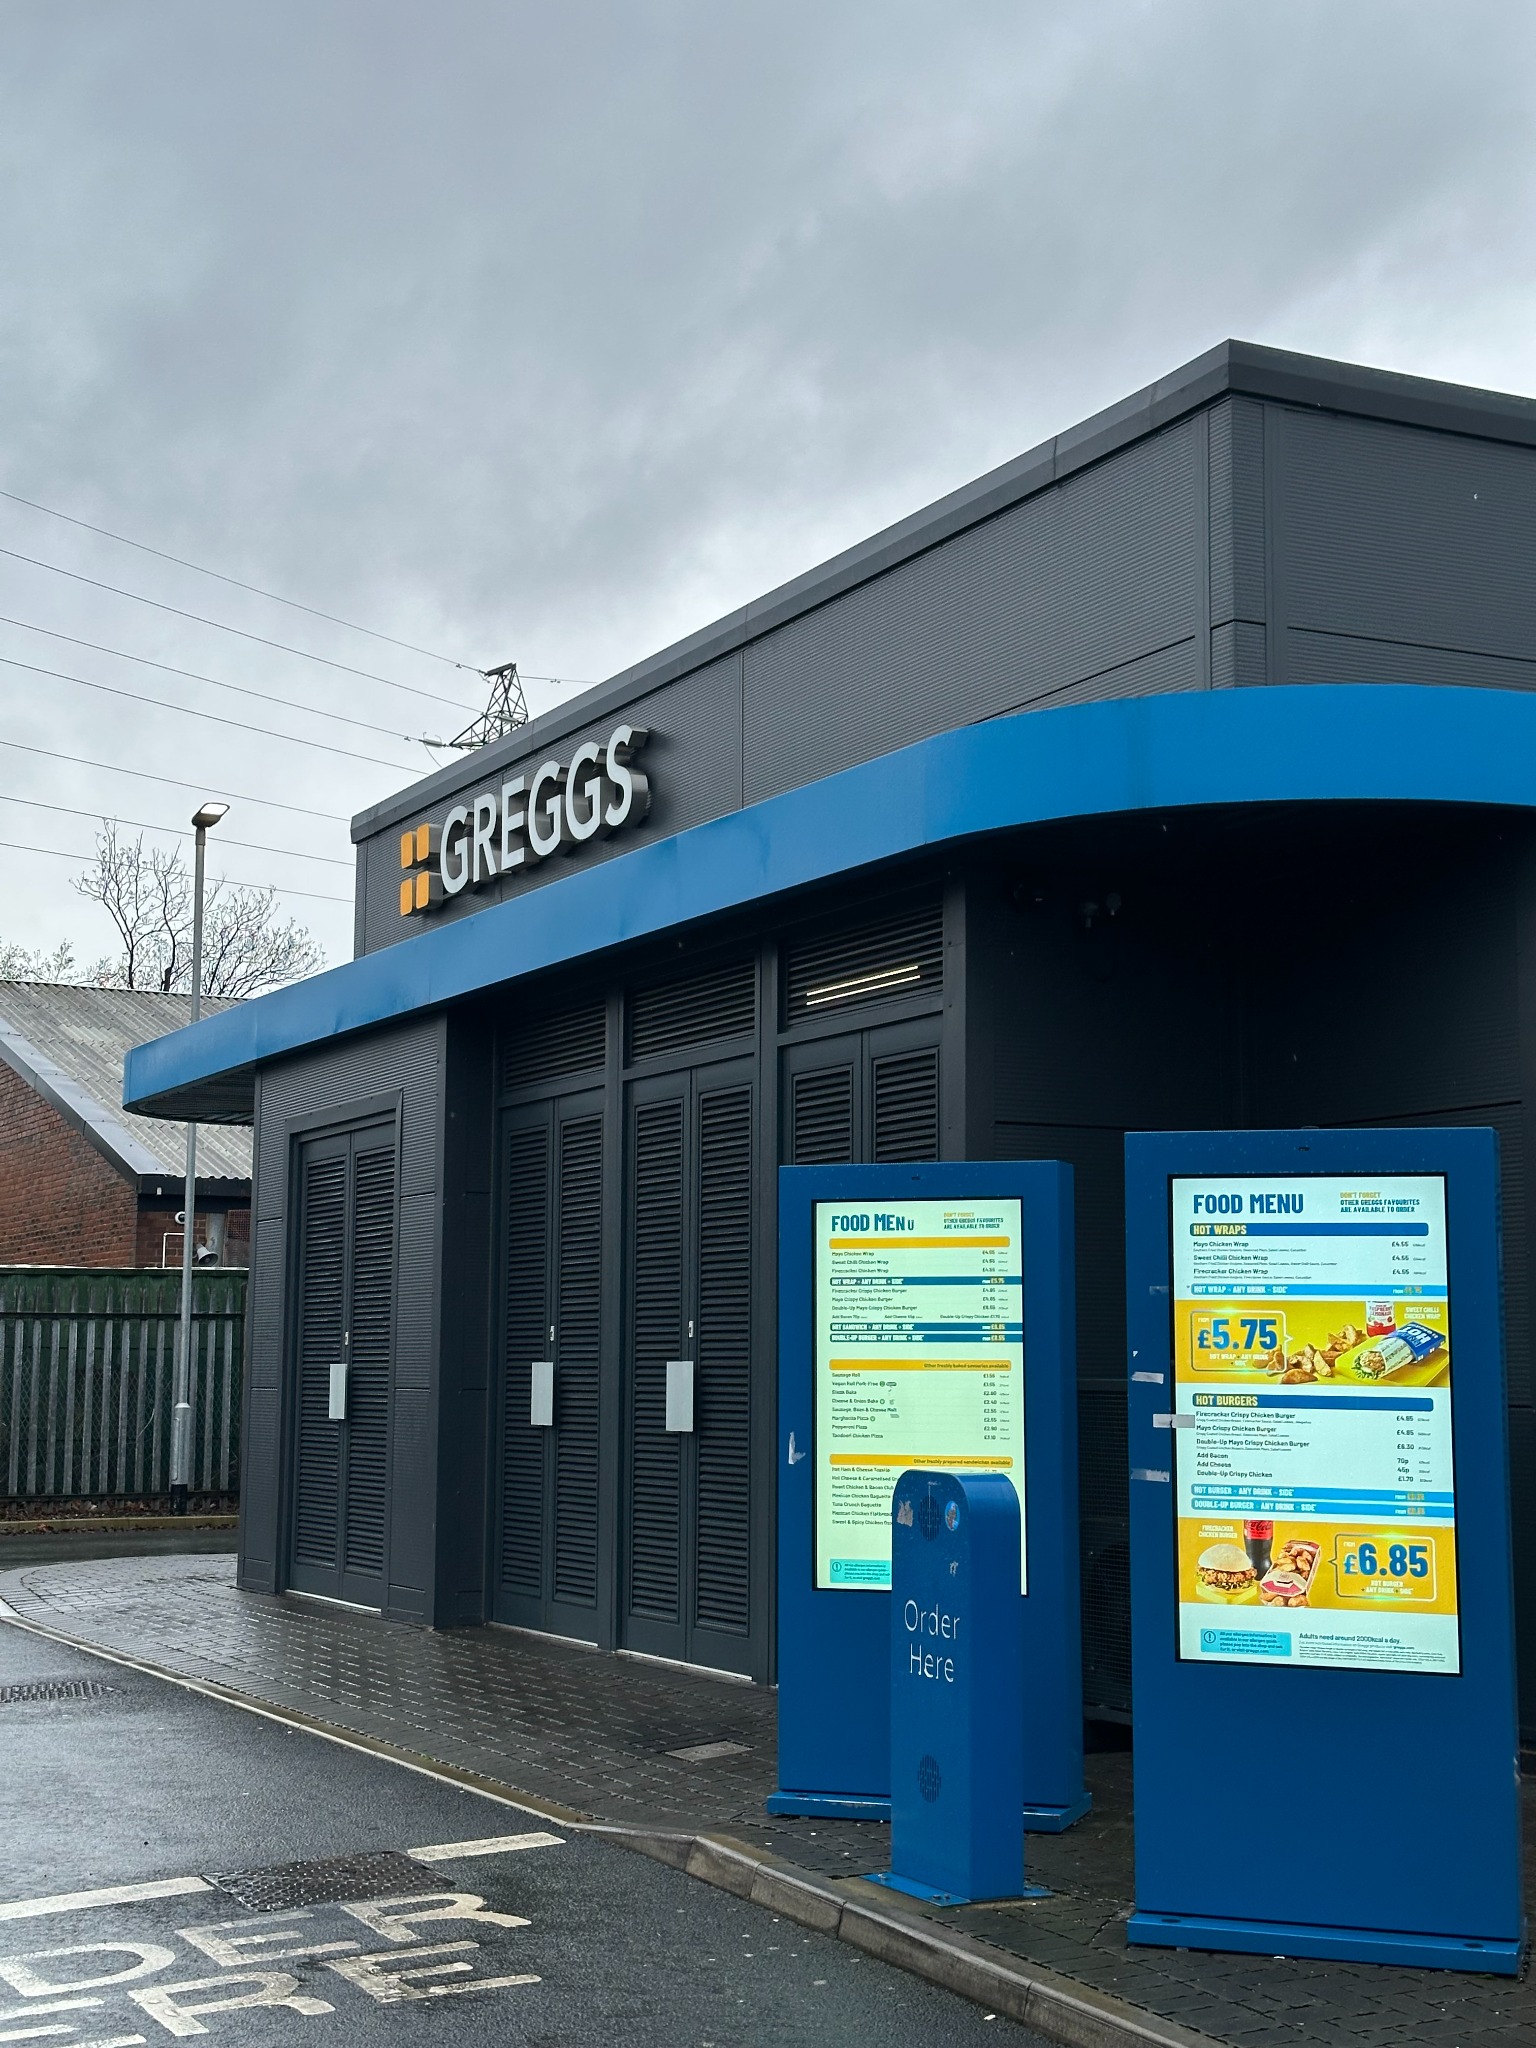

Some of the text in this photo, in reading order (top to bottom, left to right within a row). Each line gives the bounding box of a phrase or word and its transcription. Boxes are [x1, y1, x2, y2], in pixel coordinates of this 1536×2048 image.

[440, 724, 634, 894] GREGGS
[1193, 1194, 1303, 1214] FOOD MENU
[832, 1213, 914, 1231] FOOD MENU
[1193, 1225, 1247, 1234] HOT WRAPS
[1198, 1318, 1277, 1350] £5.75
[1196, 1395, 1258, 1406] HOT BURGERS
[1343, 1543, 1428, 1578] £6.85
[904, 1599, 960, 1640] Order
[1356, 1635, 1384, 1643] 2000kcal
[909, 1642, 954, 1683] Here
[0, 1892, 532, 1997] DER
